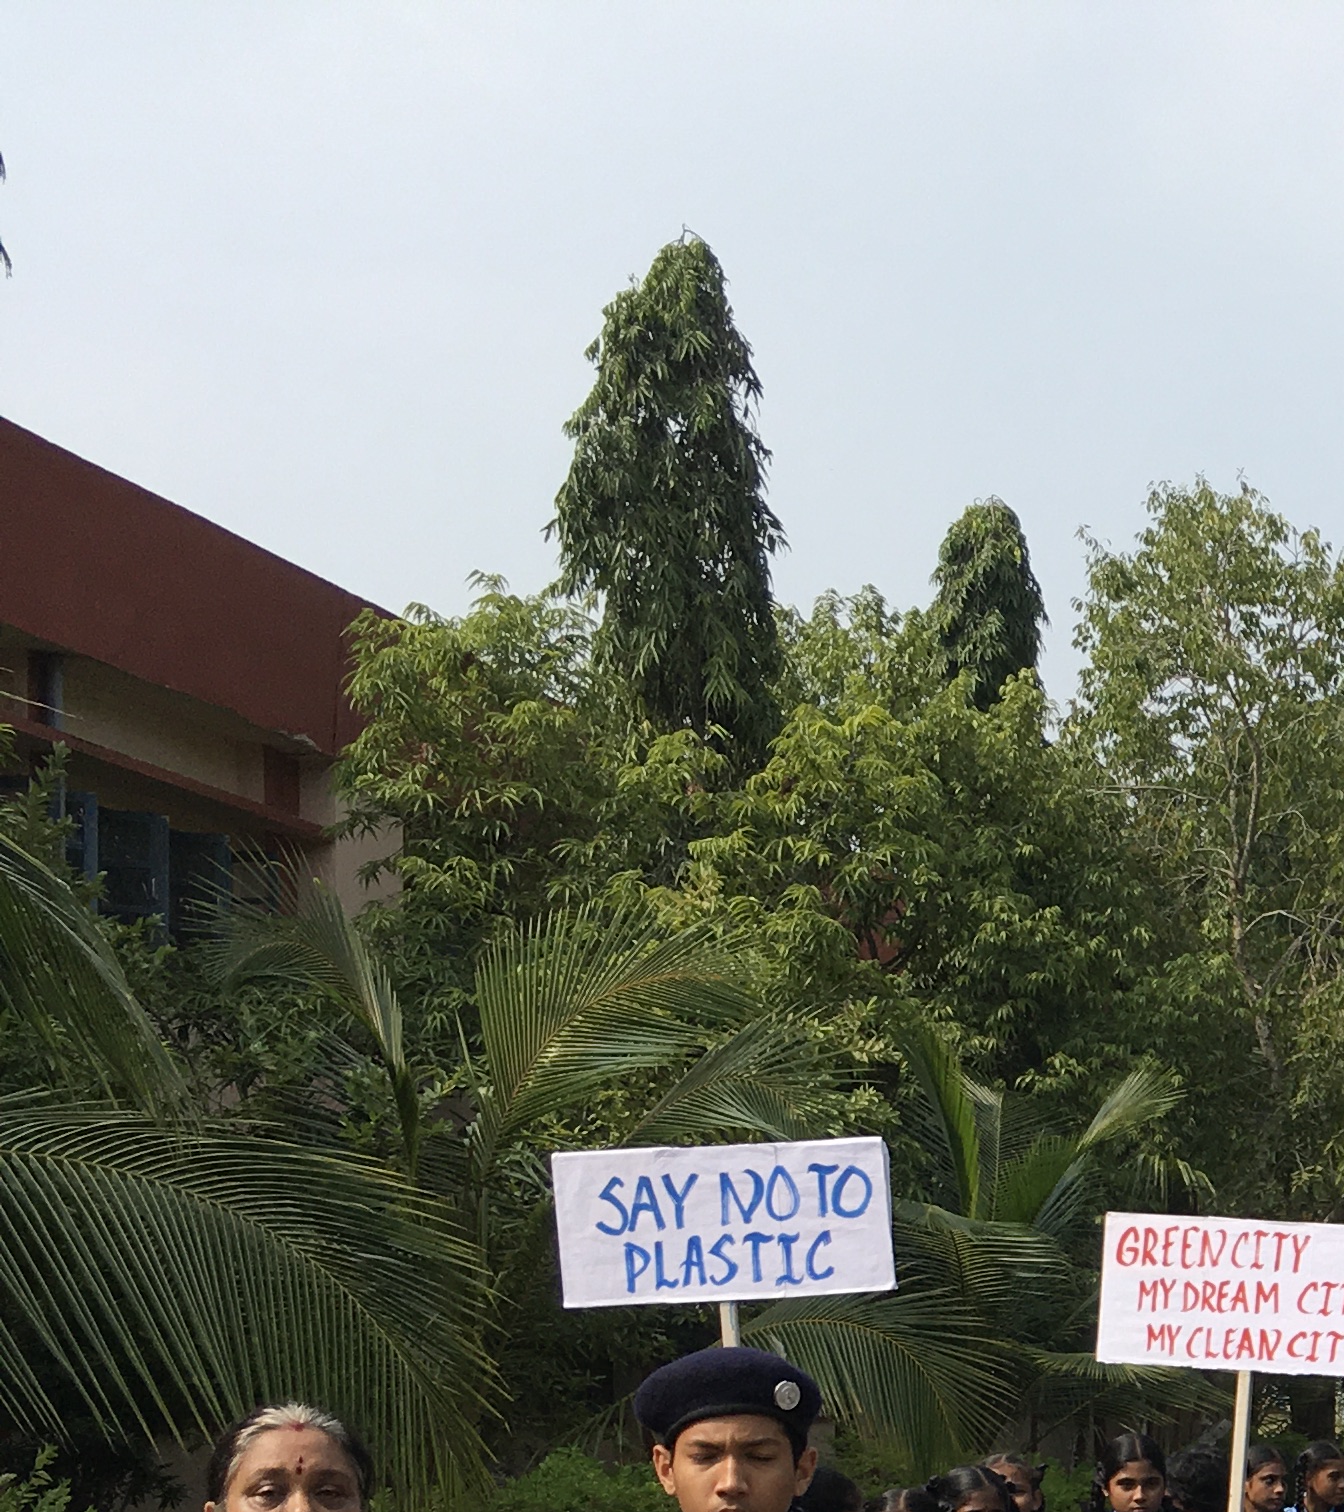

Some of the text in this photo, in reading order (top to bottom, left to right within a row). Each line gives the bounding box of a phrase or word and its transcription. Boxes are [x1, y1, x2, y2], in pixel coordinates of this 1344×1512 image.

[595, 1173, 699, 1236] SAY
[623, 1230, 836, 1293] PLASTIC
[1115, 1225, 1312, 1274] GREEN CITY
[1136, 1277, 1177, 1313] MY
[1180, 1279, 1280, 1315] DREAM
[1145, 1322, 1183, 1357] MY
[1185, 1326, 1283, 1362] CLEAN
